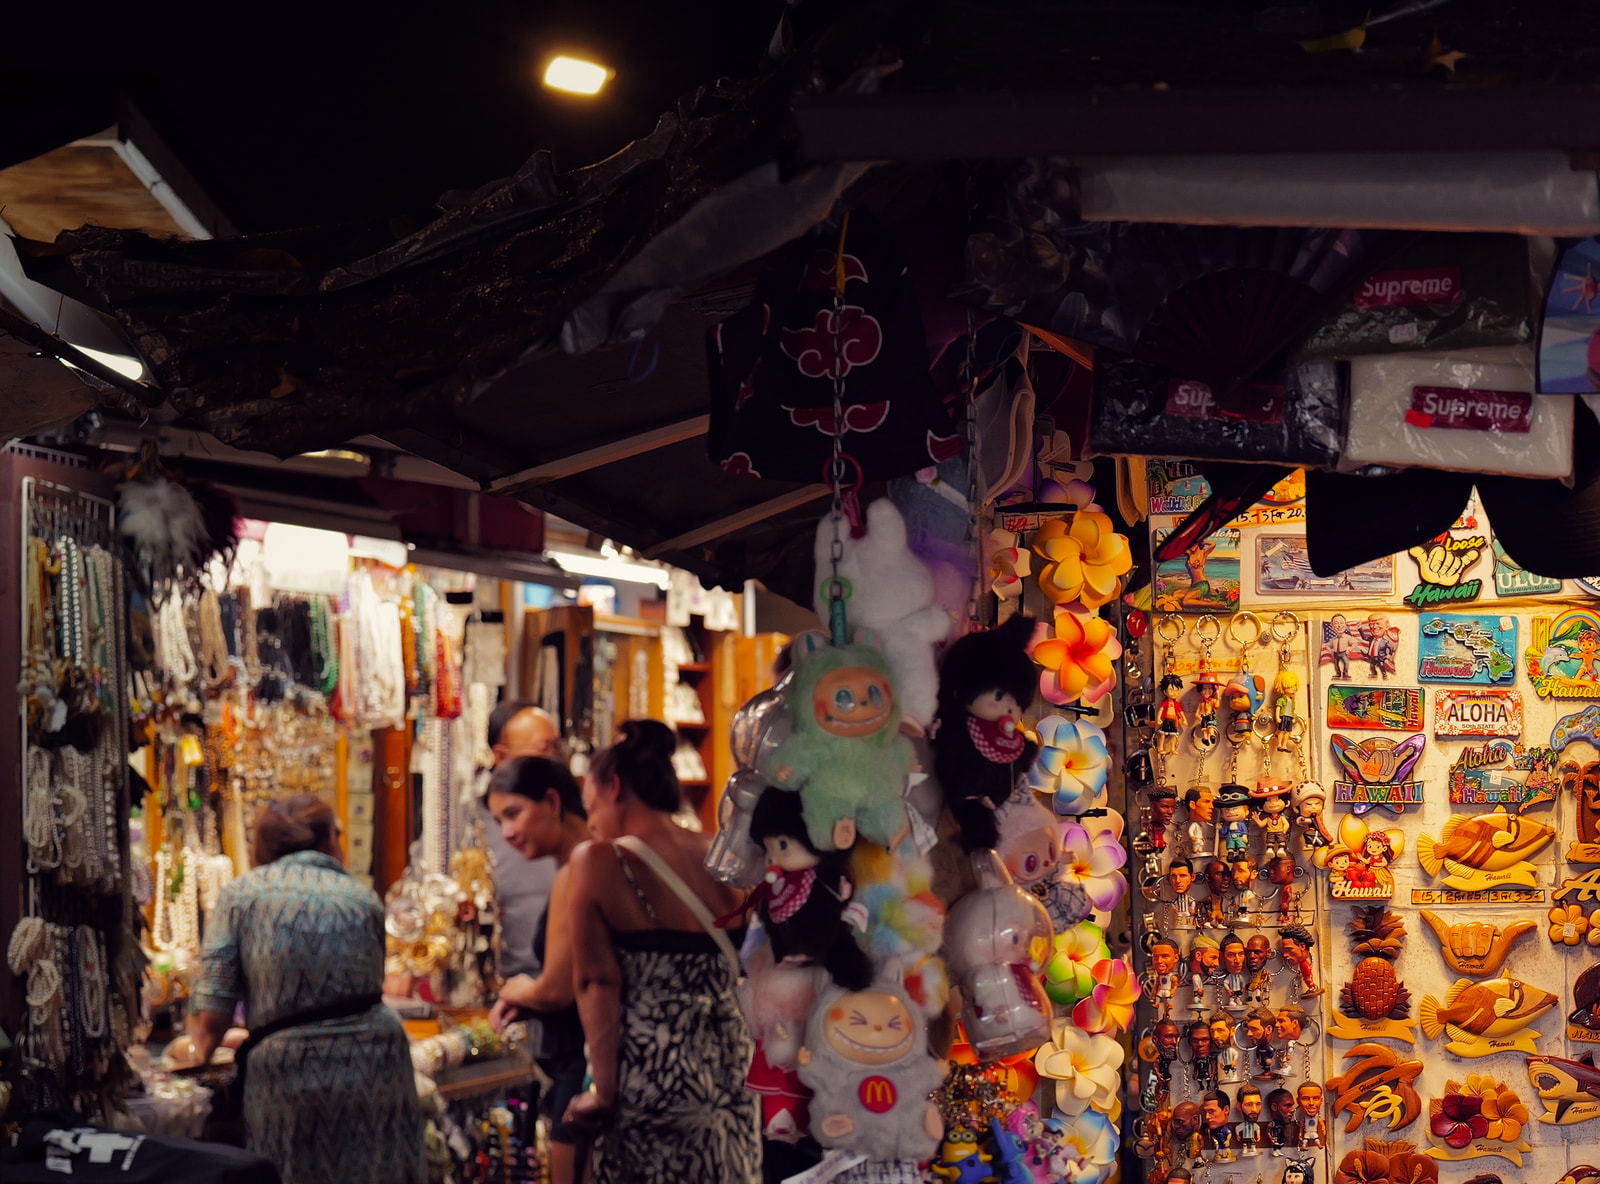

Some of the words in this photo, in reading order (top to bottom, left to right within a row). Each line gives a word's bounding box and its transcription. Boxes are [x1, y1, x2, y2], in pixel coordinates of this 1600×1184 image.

[1362, 276, 1452, 302] Supreme
[1424, 393, 1522, 422] Supreme
[1445, 536, 1486, 551] Loose
[1410, 582, 1479, 606] Hawaii
[1421, 661, 1473, 677] Hawaii
[1408, 689, 1420, 728] Hawaii
[1448, 703, 1508, 722] ALOHA
[1451, 746, 1507, 772] Aloha
[1334, 781, 1424, 803] HAWAII
[1463, 786, 1521, 804] Hawaii
[1332, 880, 1393, 898] Hawaii
[1488, 1039, 1515, 1048] Hawaii
[1570, 1106, 1598, 1116] Hawaii
[1476, 1144, 1503, 1154] Hawaii
